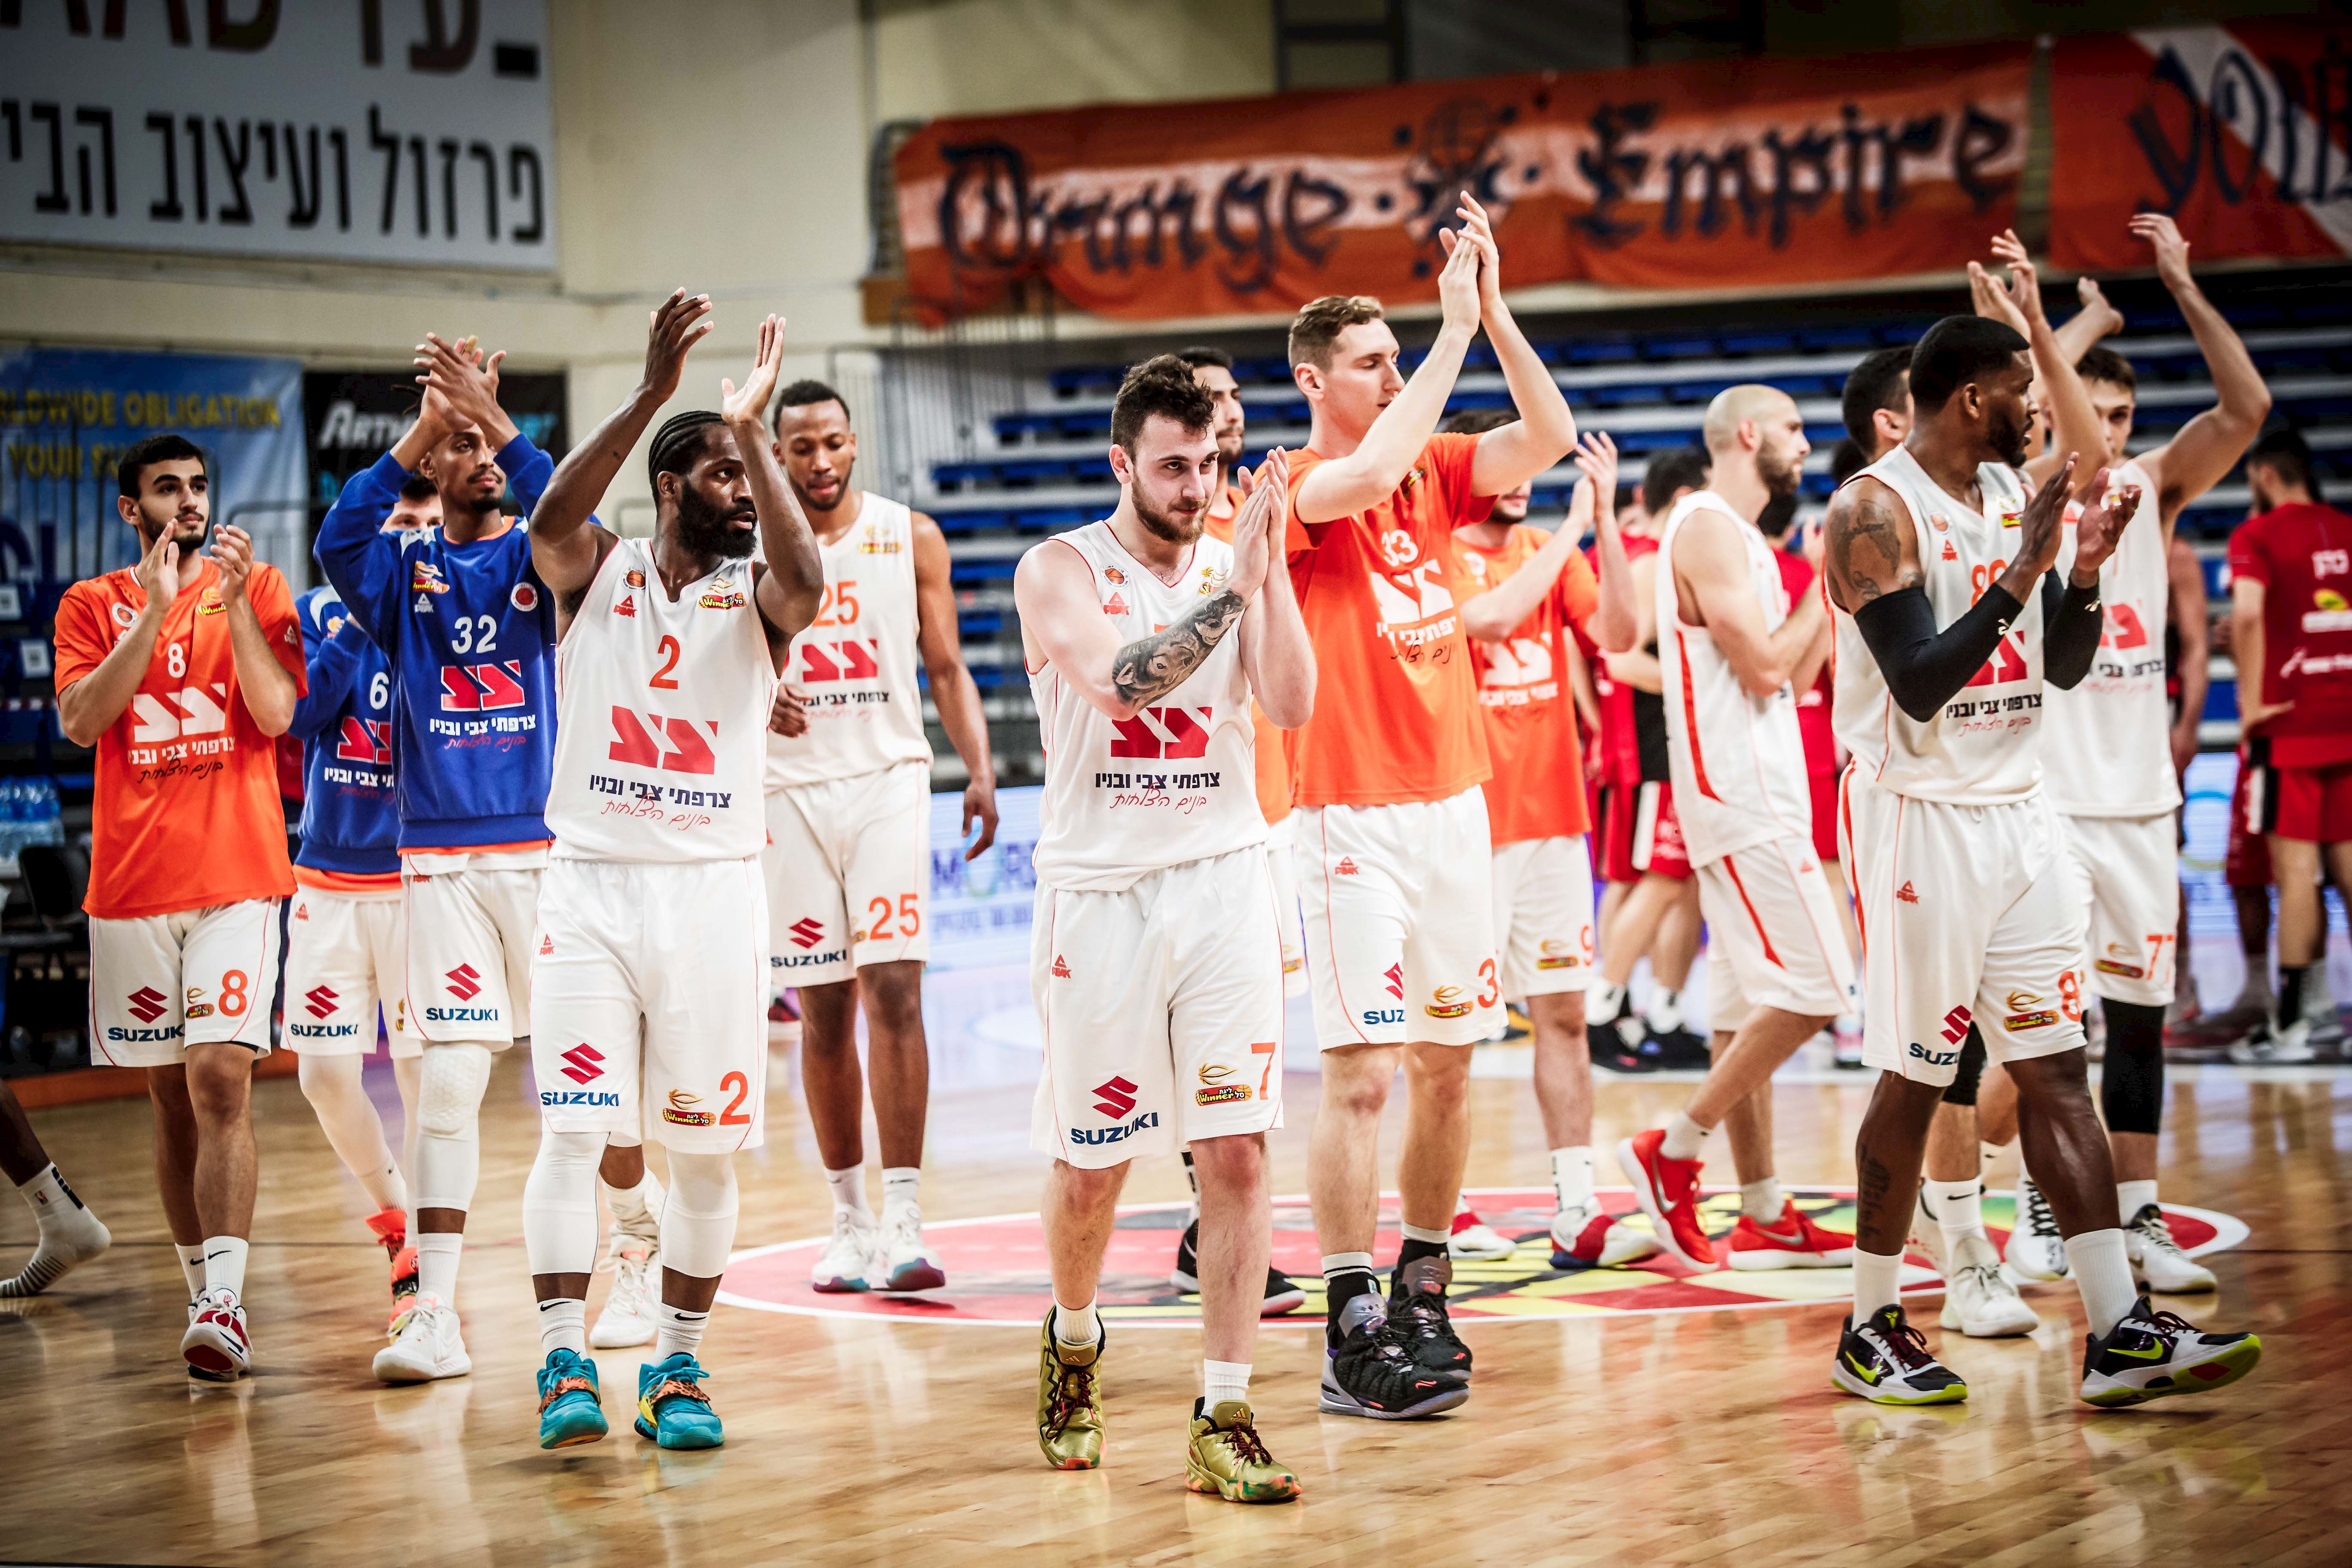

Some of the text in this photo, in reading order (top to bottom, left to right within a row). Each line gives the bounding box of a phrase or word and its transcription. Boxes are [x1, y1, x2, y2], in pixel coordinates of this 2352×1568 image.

[146, 109, 351, 233] ועיצוב
[369, 102, 544, 244] פרזול
[1569, 100, 2015, 249] Empire
[812, 581, 859, 627] 25
[452, 614, 497, 654] 32
[168, 643, 186, 678] 8
[649, 635, 681, 690] 2
[370, 671, 390, 710] 6
[1980, 700, 2000, 715] צבי
[429, 714, 537, 736] צרפתי צבי ובניו
[589, 774, 732, 809] צרפתי צבי ובניו
[1095, 772, 1220, 789] צרפתי צבי ובניו
[868, 893, 920, 940] 25
[771, 948, 847, 968] SUZUKI
[218, 969, 248, 1017] 8
[1477, 958, 1499, 1008] 3
[291, 1024, 358, 1037] SUZUKI
[426, 1008, 499, 1021] SUZUKI
[1364, 1009, 1405, 1025] SUZ
[108, 1024, 185, 1042] SUZUK
[1251, 1042, 1276, 1100] 7
[1909, 1042, 1958, 1067] SUZ
[540, 1091, 620, 1107] SUZUKI
[719, 1070, 751, 1125] 2
[1199, 1093, 1234, 1103] Winner
[1234, 1090, 1245, 1098] סל
[667, 1112, 700, 1124] Winner
[1070, 1111, 1159, 1145] SUZUKI
